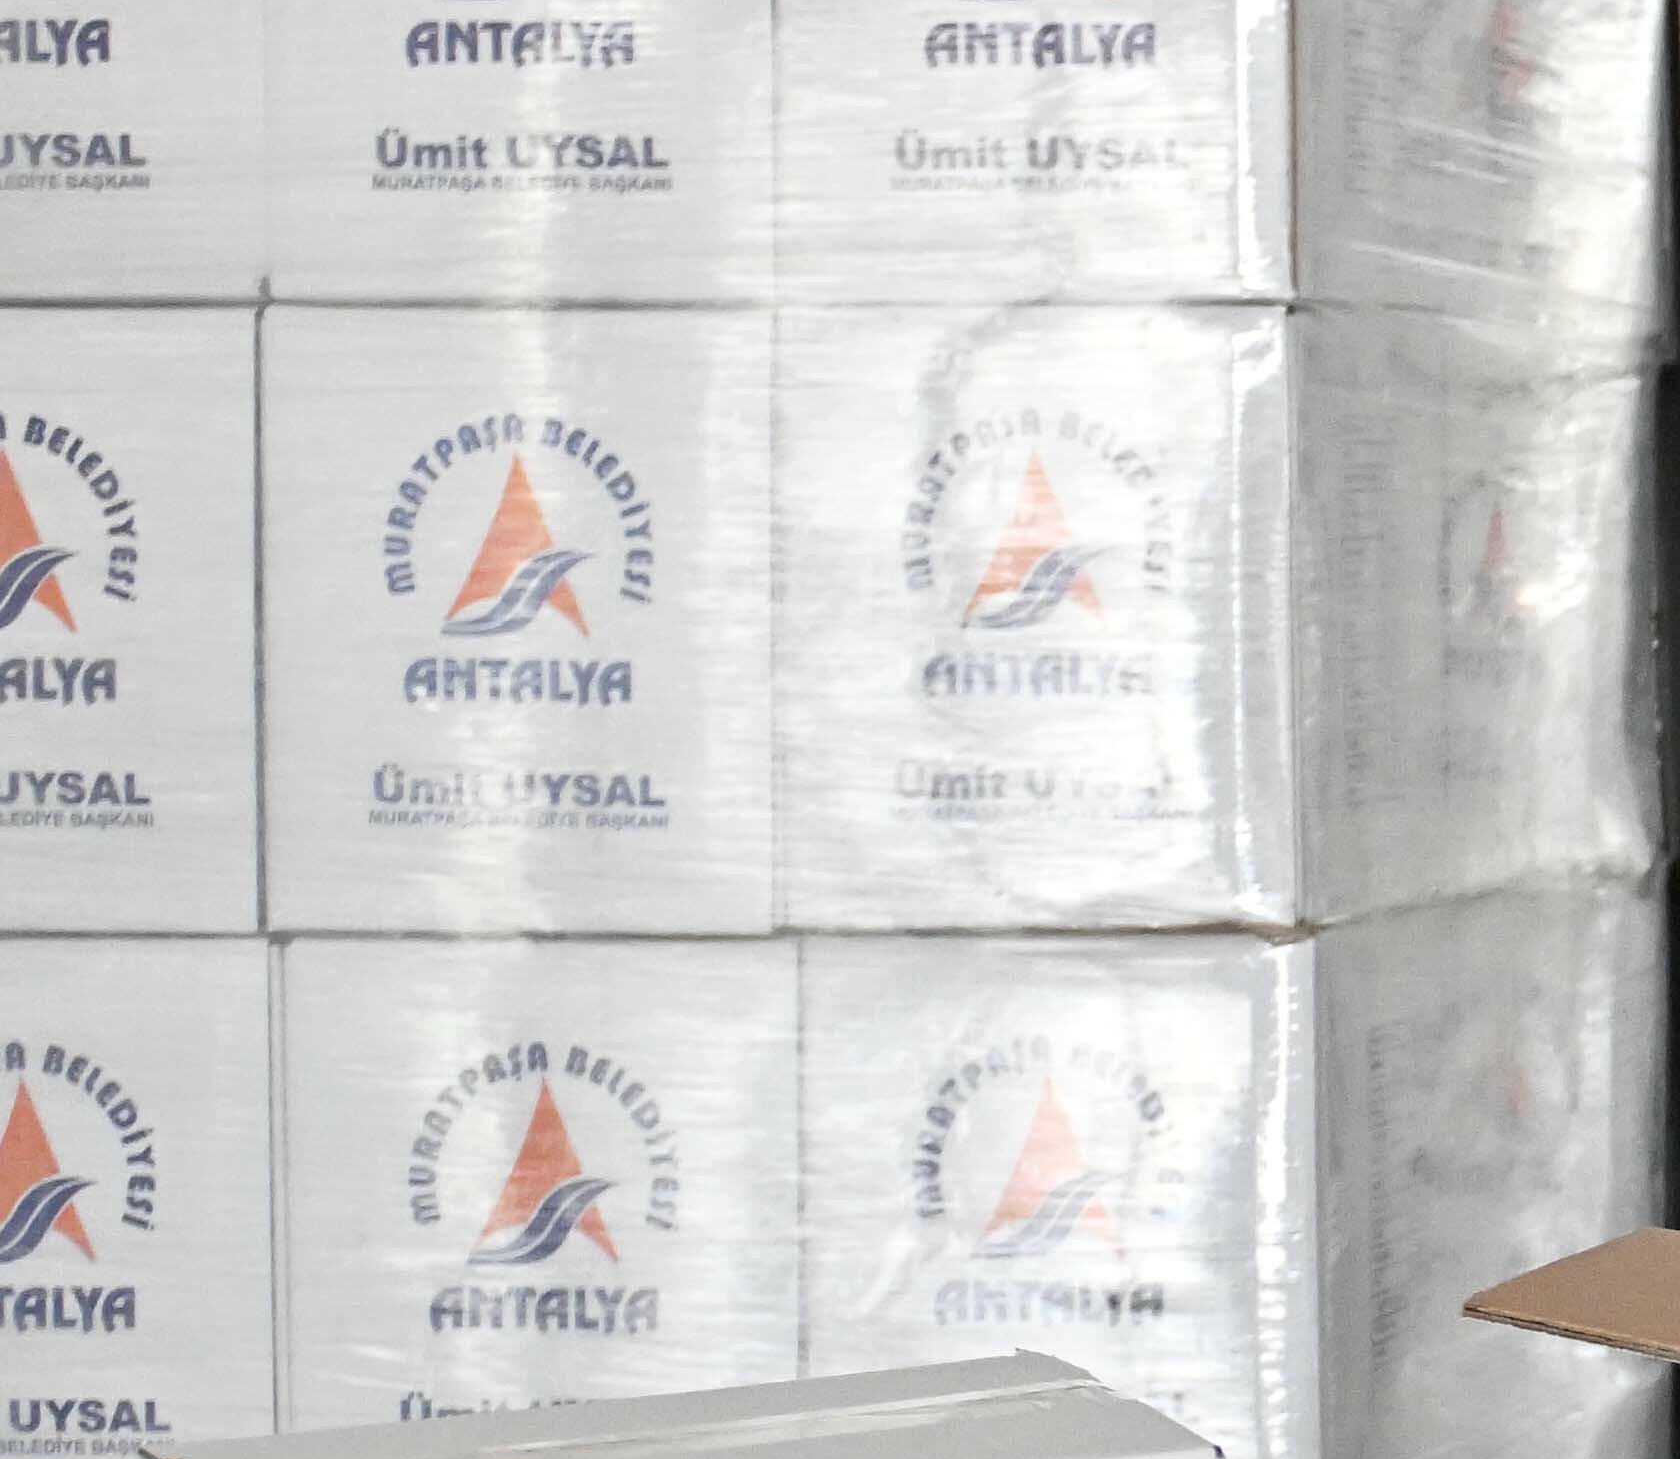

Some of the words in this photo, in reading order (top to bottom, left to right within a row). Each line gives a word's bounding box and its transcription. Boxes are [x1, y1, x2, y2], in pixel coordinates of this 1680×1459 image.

[407, 20, 636, 68] ANTALYA
[925, 21, 1157, 70] ANTALYA
[376, 126, 488, 169] Ümit
[404, 656, 633, 708] ANTALYA
[504, 773, 664, 809] UYSAL
[10, 1399, 168, 1433] UYSAL
